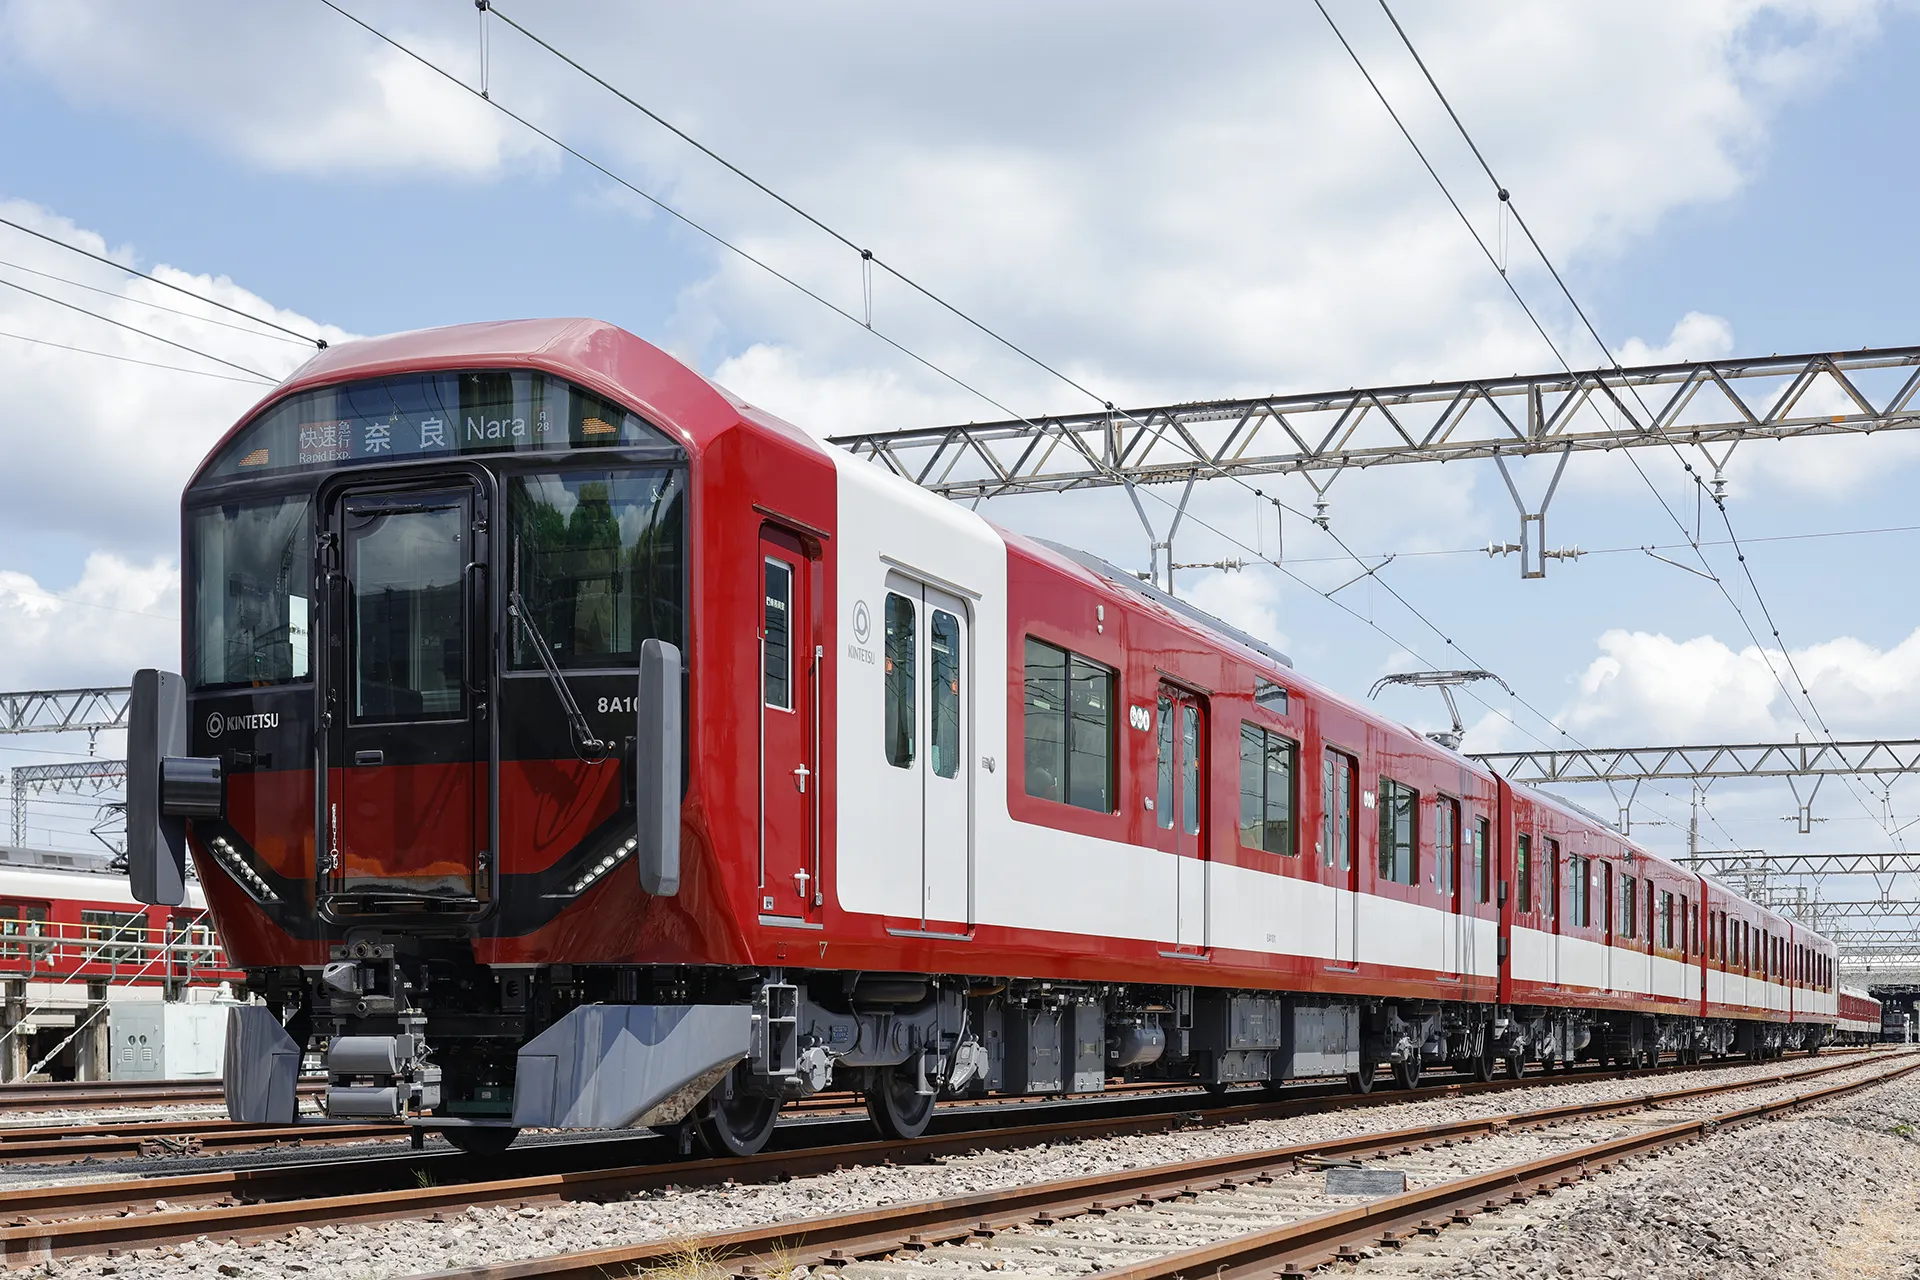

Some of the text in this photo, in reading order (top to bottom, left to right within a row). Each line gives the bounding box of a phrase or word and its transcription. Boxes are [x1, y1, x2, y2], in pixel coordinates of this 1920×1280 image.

[467, 415, 526, 441] Nara
[536, 421, 550, 432] 28
[299, 449, 351, 464] Rapid Exp.
[847, 644, 876, 665] KINTETSU
[226, 712, 279, 731] KINTETSU
